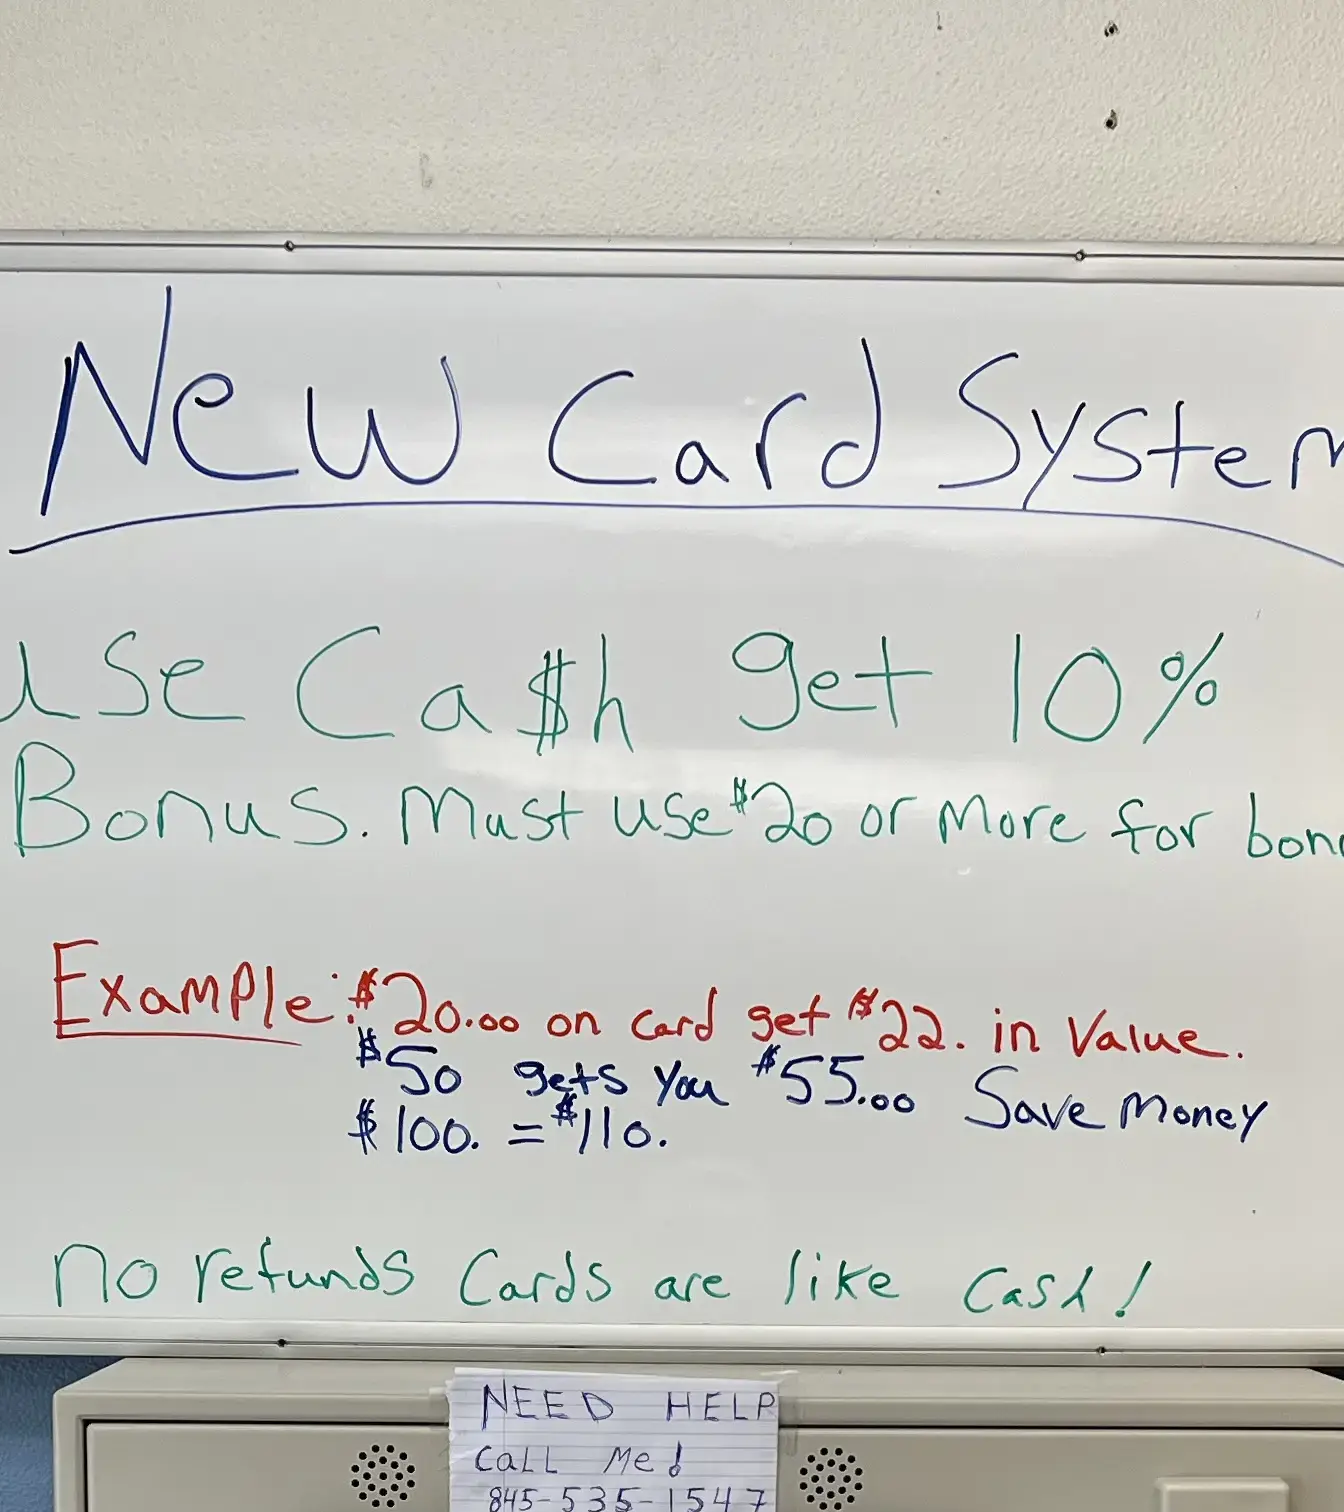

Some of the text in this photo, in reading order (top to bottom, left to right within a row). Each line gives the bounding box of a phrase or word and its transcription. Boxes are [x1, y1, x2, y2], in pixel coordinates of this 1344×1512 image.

[548, 338, 881, 489] Card
[295, 627, 636, 756] Ca$h
[731, 630, 933, 732] get
[13, 741, 369, 858] Bonus.
[613, 790, 732, 843] use
[731, 776, 834, 846] $20
[859, 794, 919, 838] or
[1110, 797, 1213, 856] for
[348, 966, 521, 1036] $20.00
[546, 1011, 603, 1038] on
[629, 986, 719, 1043] card
[747, 994, 831, 1044] get
[993, 1007, 1040, 1056] in
[348, 1097, 480, 1155] $100.
[356, 1026, 462, 1096] $50
[513, 1060, 629, 1099] gets
[751, 1044, 916, 1115] $55.00
[963, 1066, 1106, 1131] Save
[195, 1235, 415, 1305] refunds
[654, 1269, 731, 1302] are
[784, 1249, 901, 1307] like
[482, 1380, 776, 1431] NEED HELP
